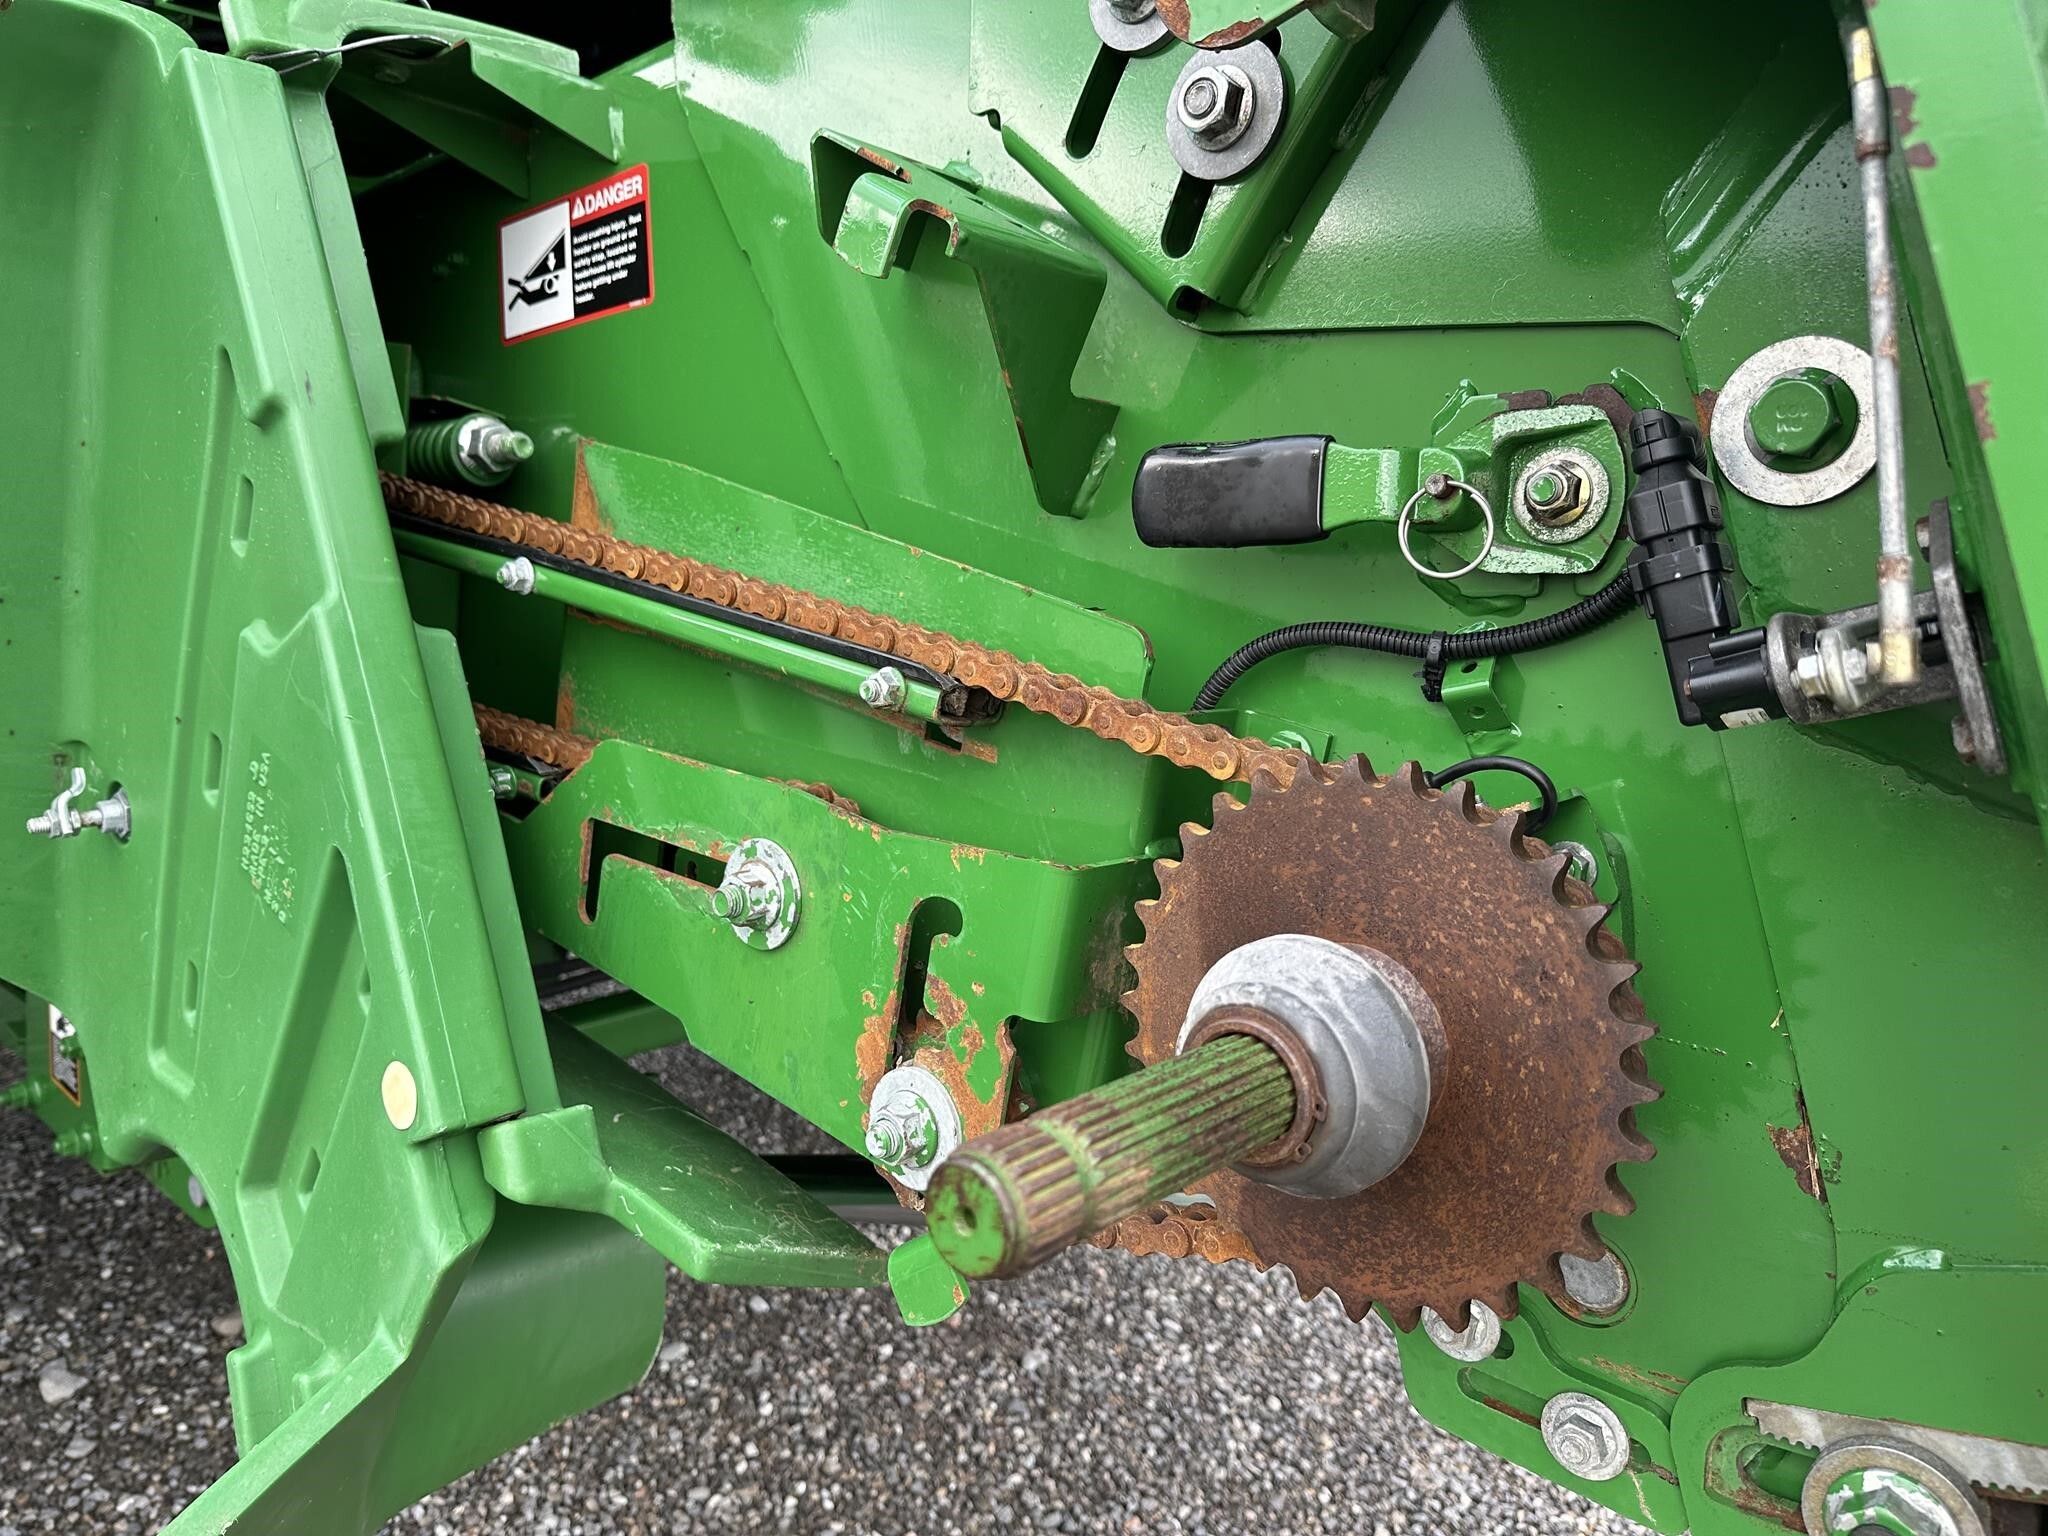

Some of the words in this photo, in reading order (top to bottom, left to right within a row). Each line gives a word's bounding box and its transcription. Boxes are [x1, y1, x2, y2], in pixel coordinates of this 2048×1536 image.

[584, 175, 643, 215] DANGER
[588, 225, 610, 240] crushing
[600, 233, 620, 249] ground
[258, 752, 271, 787] USA
[256, 797, 264, 817] IN
